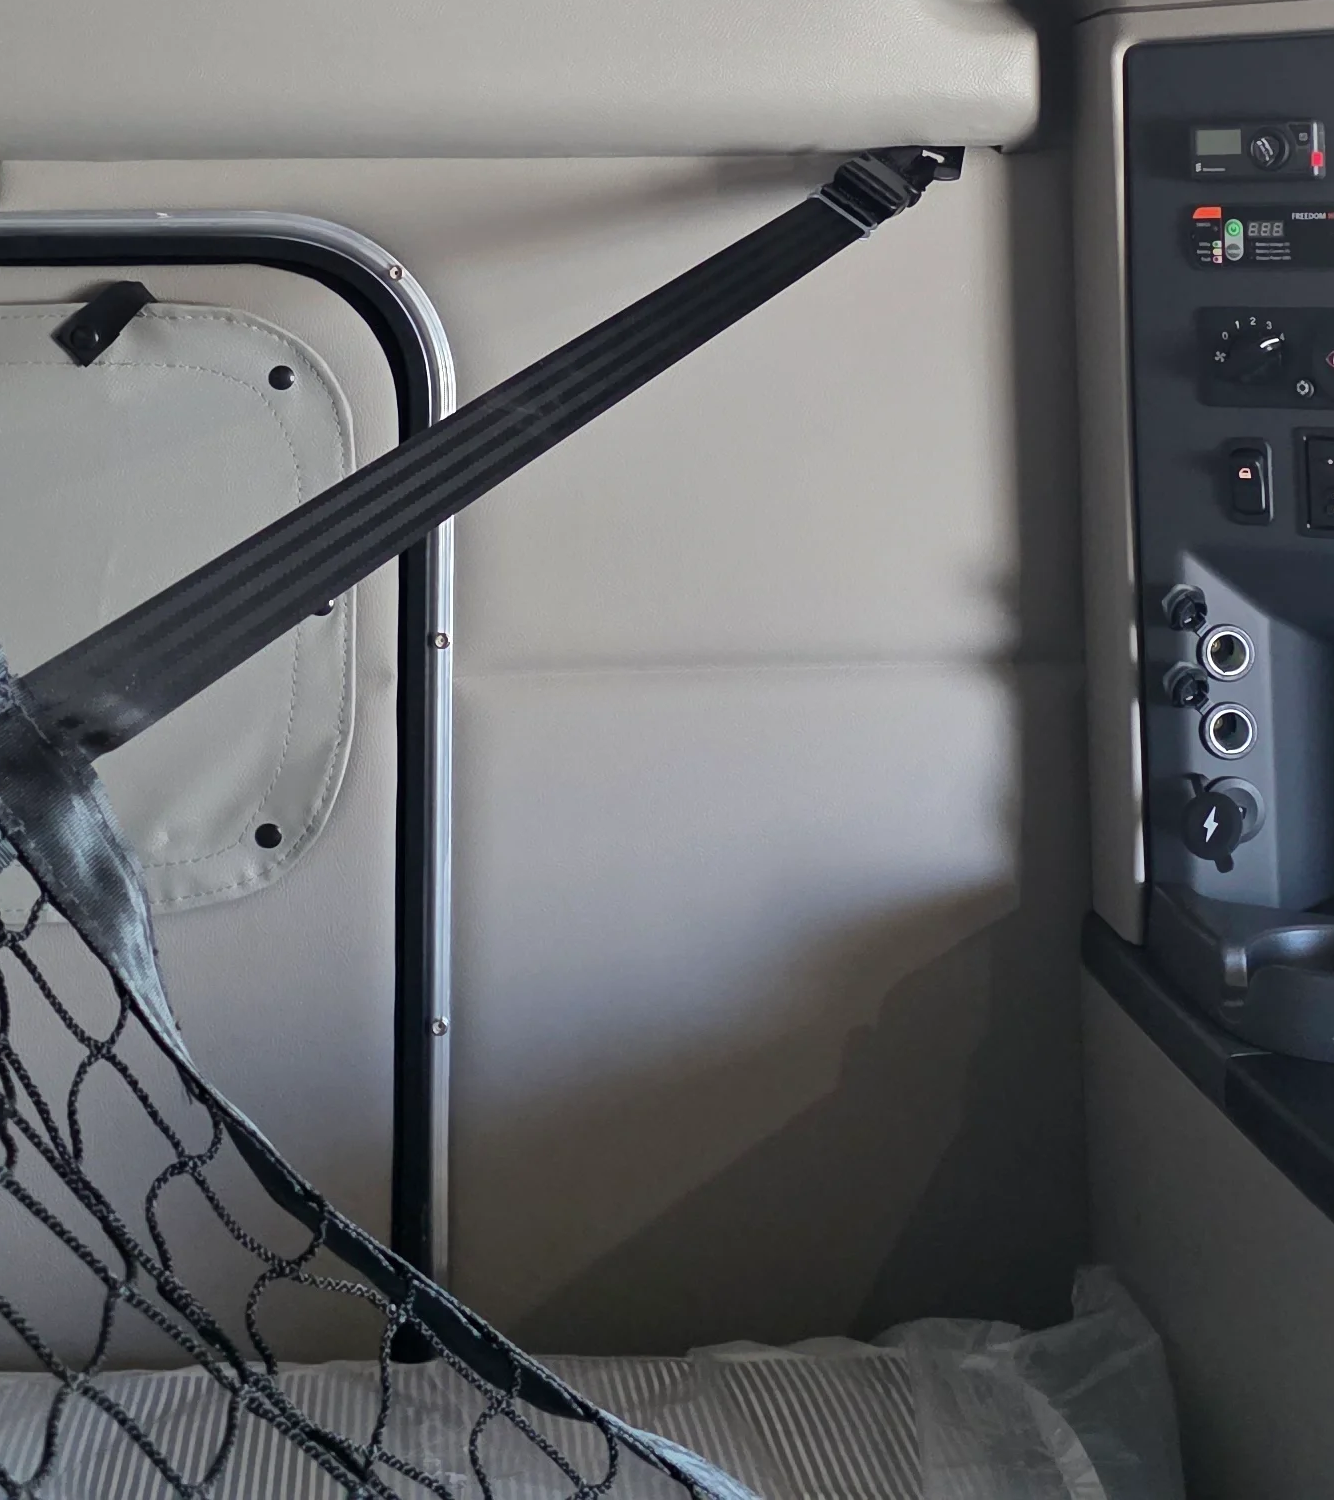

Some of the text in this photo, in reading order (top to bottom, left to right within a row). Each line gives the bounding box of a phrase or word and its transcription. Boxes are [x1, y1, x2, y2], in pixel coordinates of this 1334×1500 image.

[1291, 211, 1327, 220] FREEDOM
[1221, 316, 1286, 342] 0 1 2 3 4
